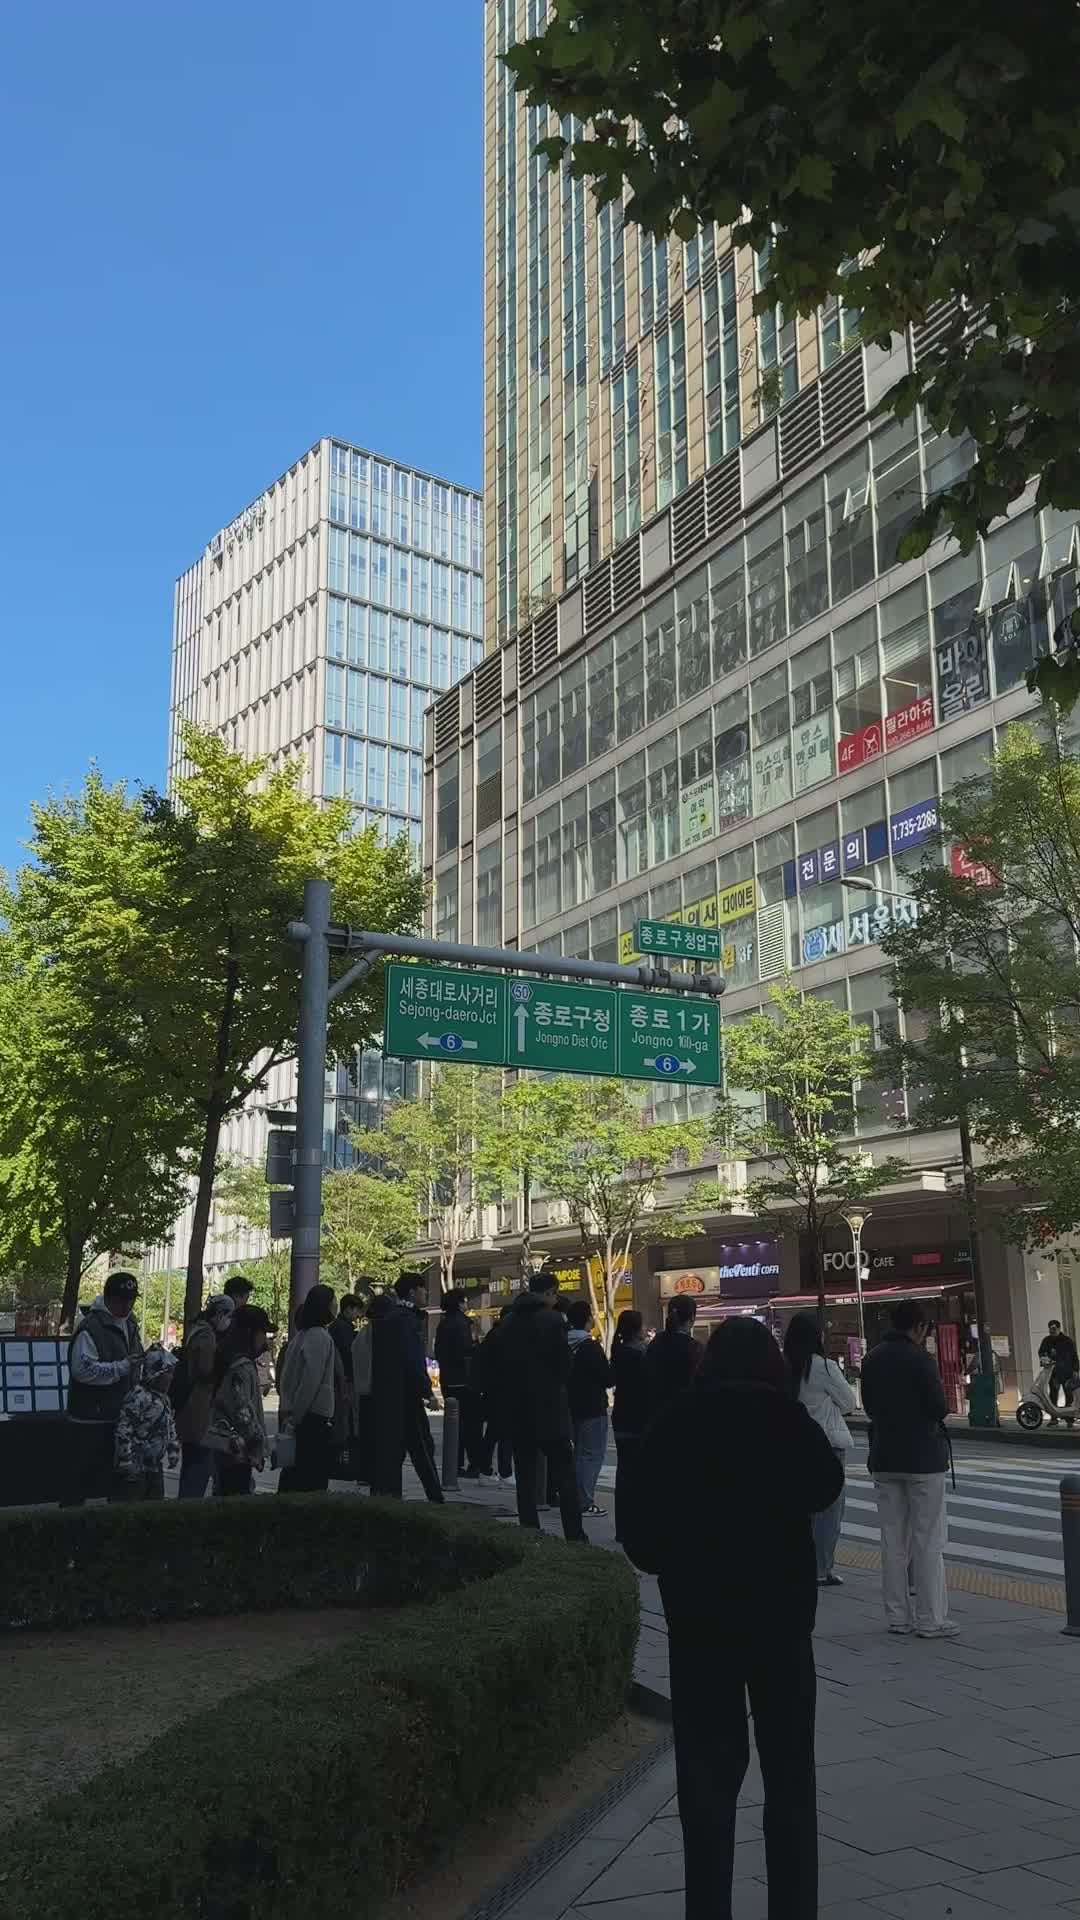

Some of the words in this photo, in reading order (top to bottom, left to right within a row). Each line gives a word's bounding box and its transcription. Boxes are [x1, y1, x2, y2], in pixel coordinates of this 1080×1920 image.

[802, 838, 859, 881] 전문의
[722, 886, 753, 914] 다이어트
[640, 926, 719, 952] 종로구청입구
[400, 976, 497, 1009] 세종대로사거리
[514, 985, 529, 999] 50
[399, 1000, 478, 1021] Sejong-daero
[479, 1010, 497, 1025] Jct
[533, 1001, 611, 1033] 종로구청
[446, 1035, 456, 1049] 6
[535, 1031, 569, 1047] Jongno
[571, 1034, 589, 1047] Dist
[590, 1036, 608, 1049] Ofc
[631, 1032, 673, 1049] Jongno
[662, 1057, 673, 1072] 6
[823, 1250, 869, 1271] FOOD
[872, 1256, 895, 1268] CAFE
